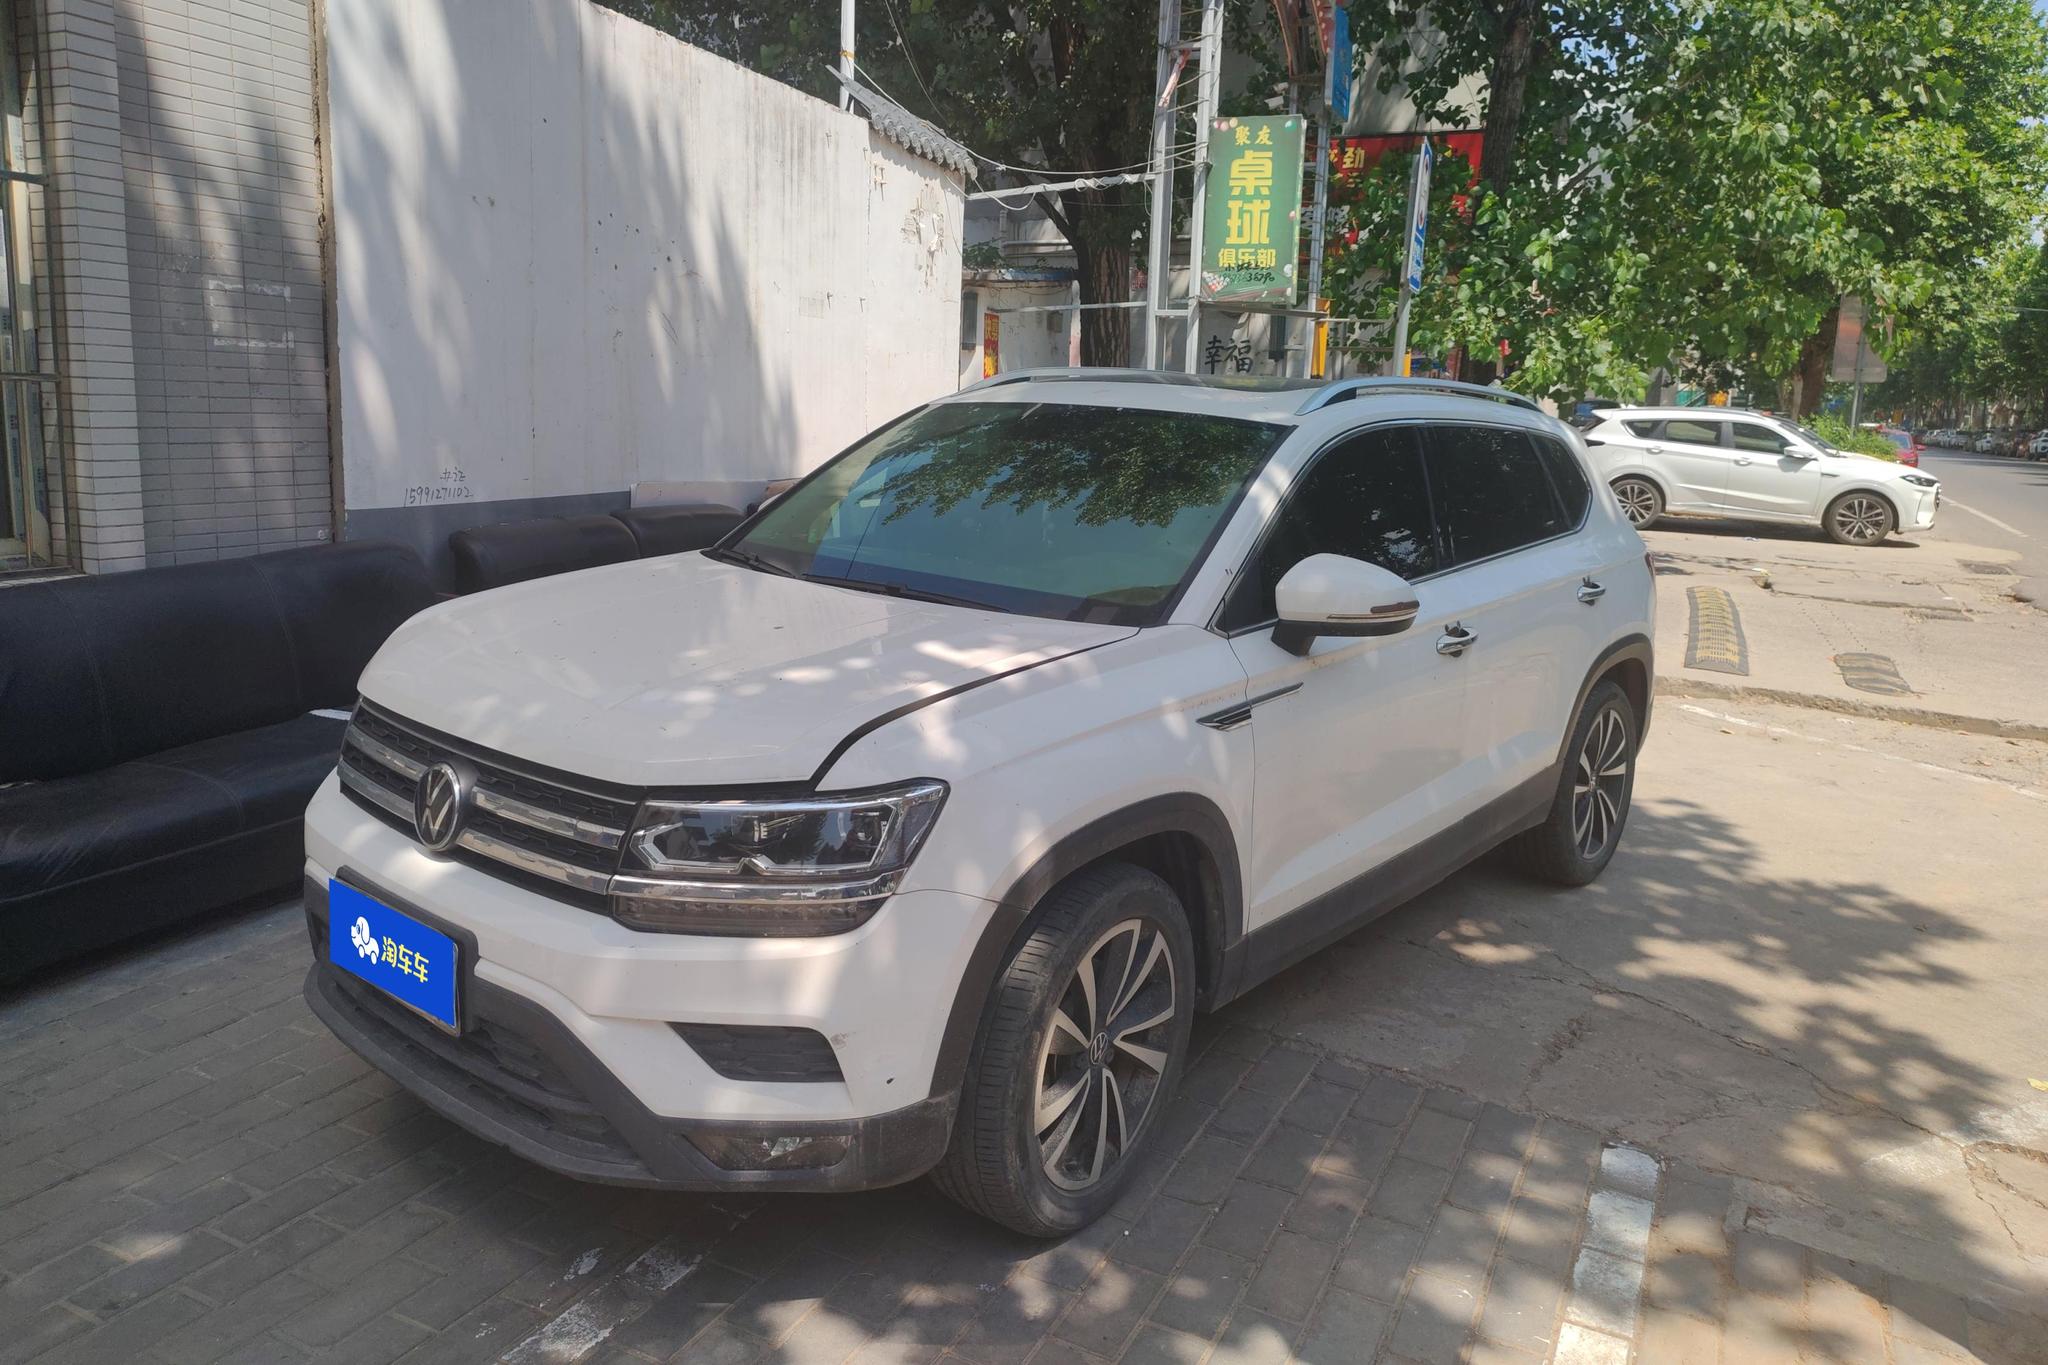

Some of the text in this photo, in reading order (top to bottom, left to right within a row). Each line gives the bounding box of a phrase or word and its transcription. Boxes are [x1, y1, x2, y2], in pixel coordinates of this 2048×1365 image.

[1235, 125, 1273, 146] 聚友
[1225, 149, 1273, 245] 桌球
[1218, 247, 1276, 268] 俱乐部
[1205, 335, 1254, 375] 幸福
